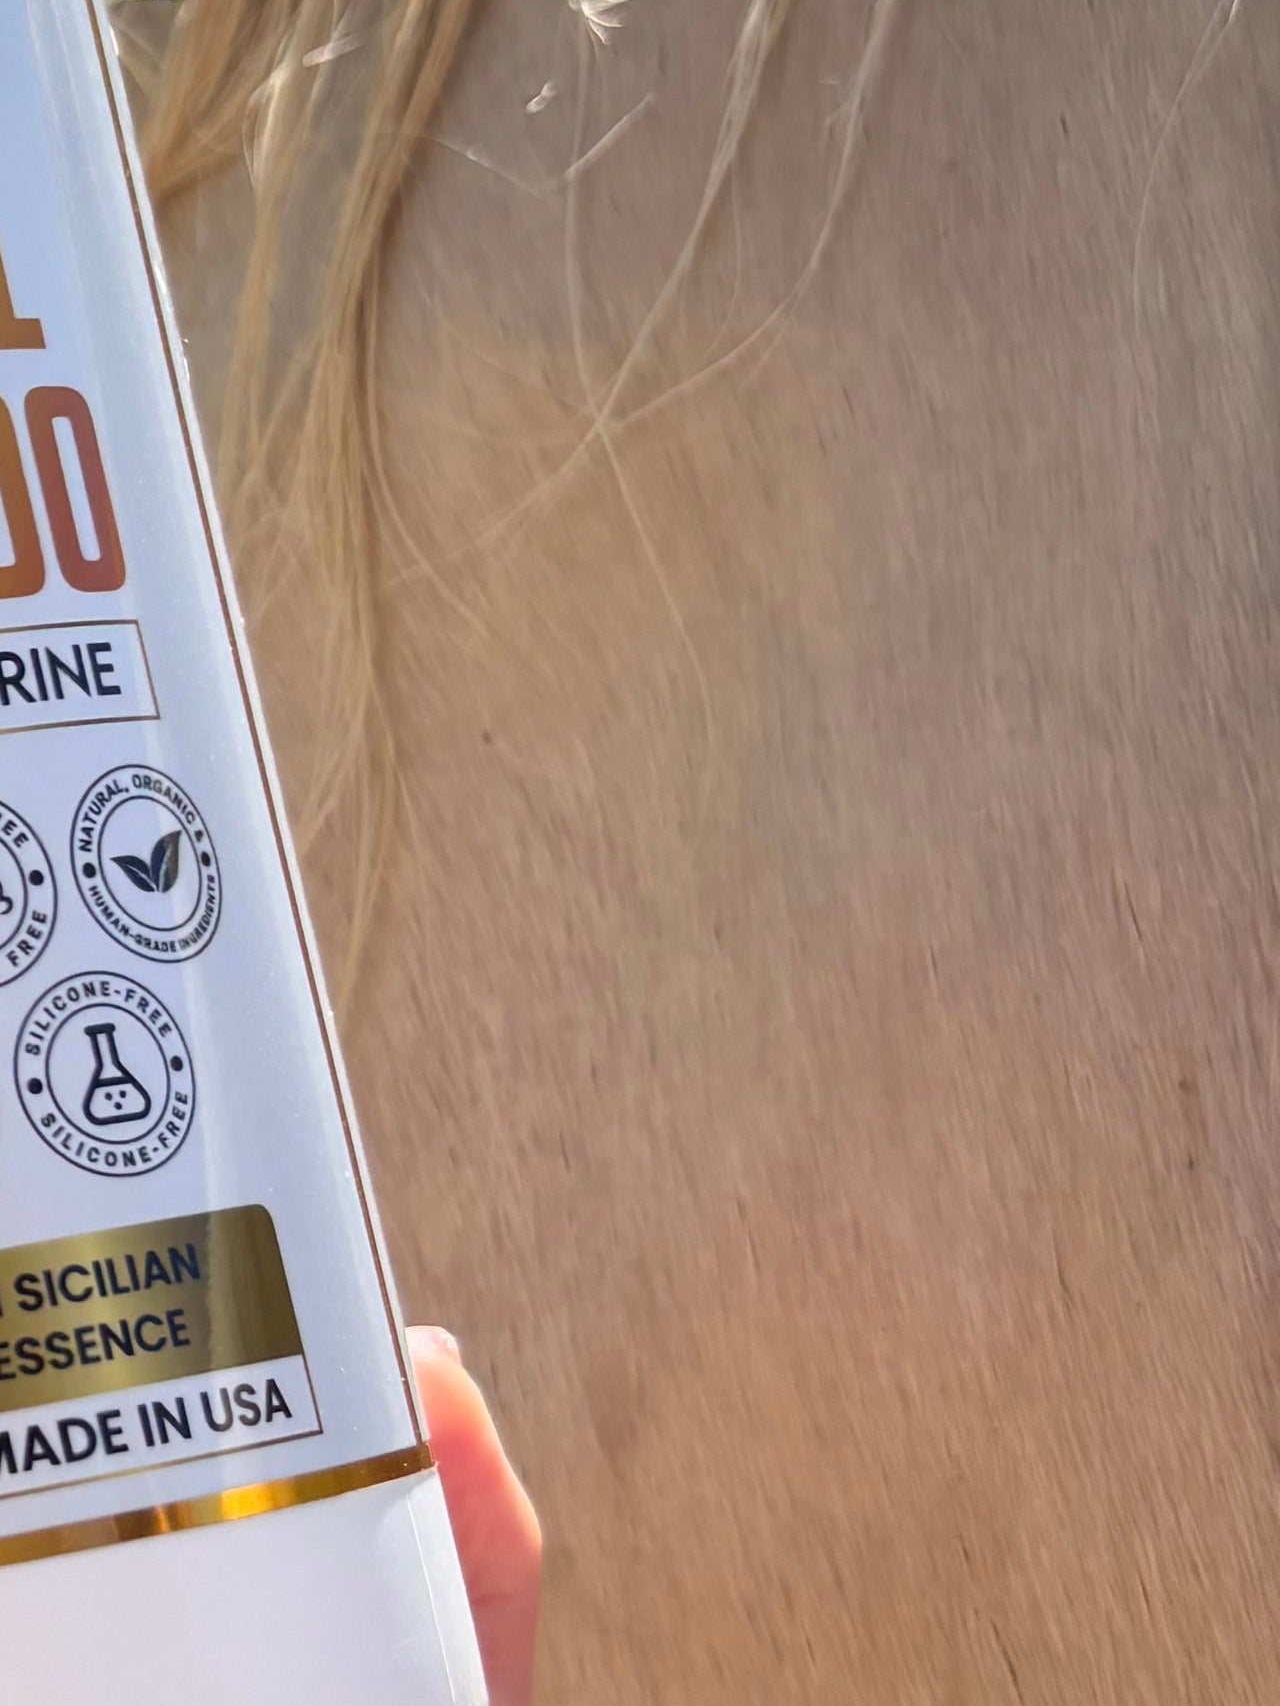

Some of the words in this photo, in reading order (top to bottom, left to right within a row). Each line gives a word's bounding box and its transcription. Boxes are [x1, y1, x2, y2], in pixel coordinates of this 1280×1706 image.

[132, 774, 196, 824] ORGANIC
[6, 909, 48, 968] FREE
[87, 885, 178, 953] HUMAN-GRADE
[25, 980, 173, 1056] SILICONE-FREE
[40, 1091, 189, 1168] SILICONE-FREE
[13, 1243, 201, 1312] SICILIAN
[137, 1396, 194, 1448] IN
[199, 1377, 293, 1433] USA
